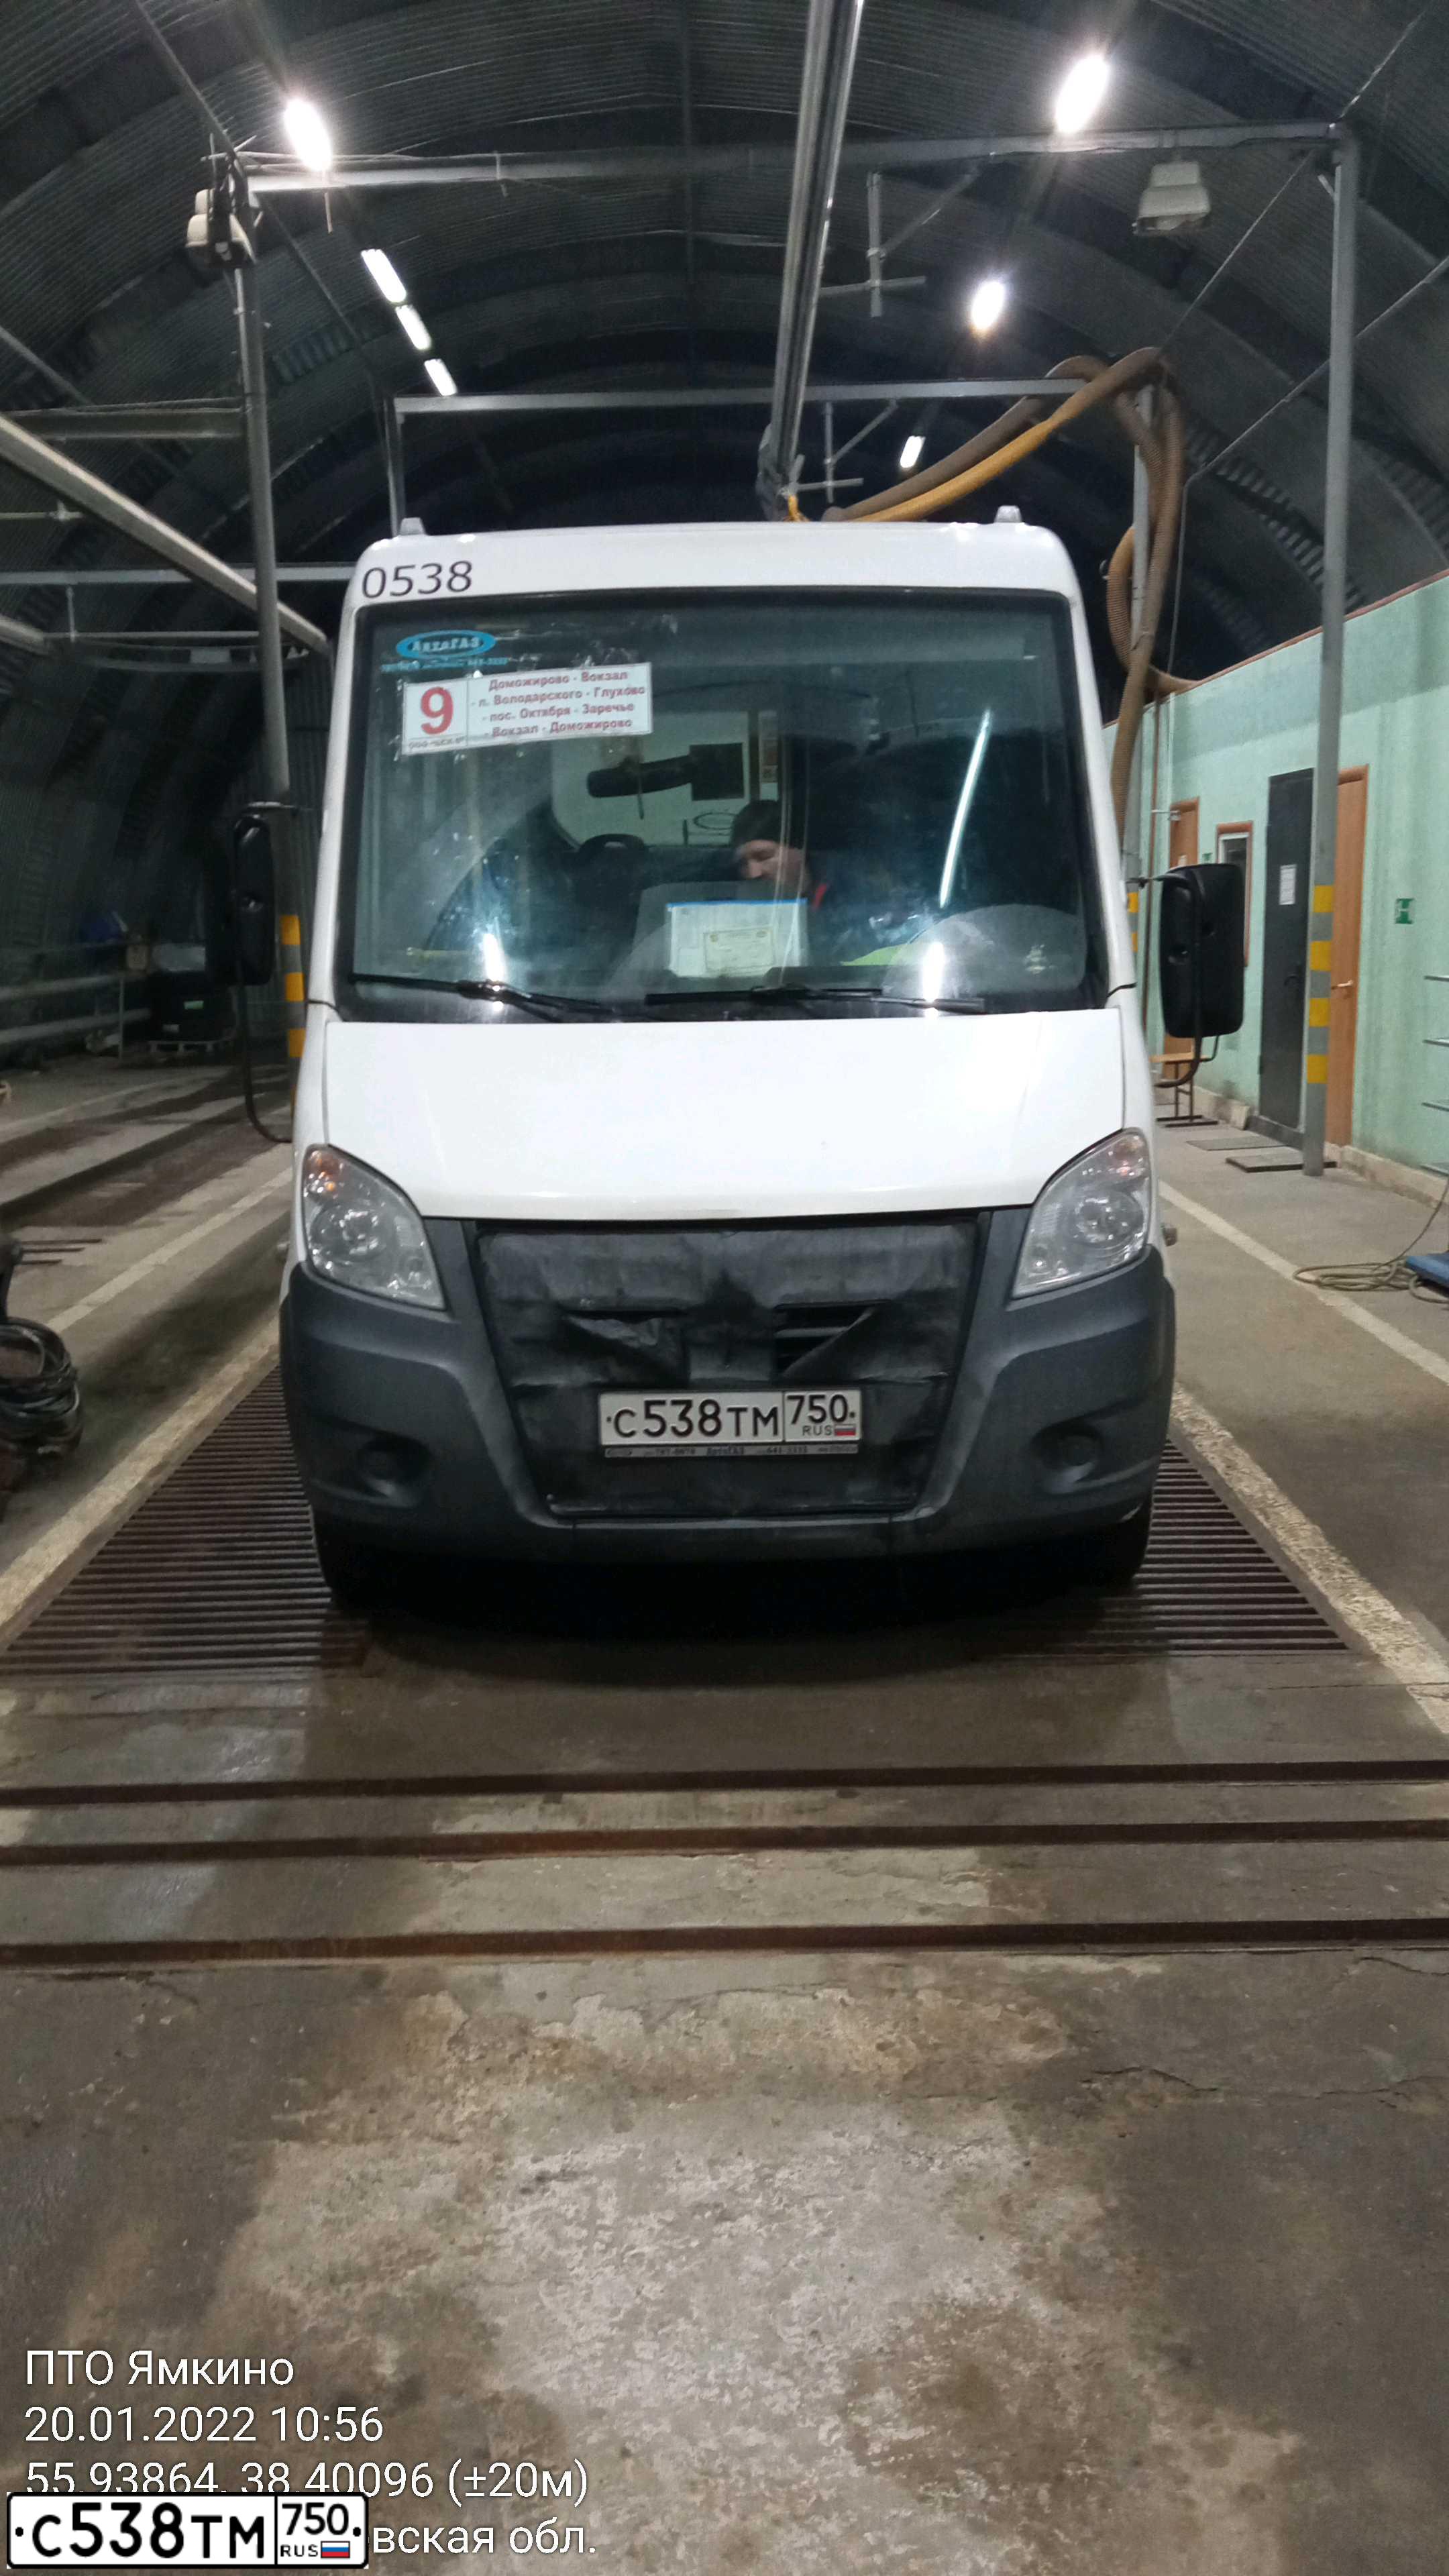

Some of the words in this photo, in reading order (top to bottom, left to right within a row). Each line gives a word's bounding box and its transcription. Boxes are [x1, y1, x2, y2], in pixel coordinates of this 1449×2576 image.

[362, 560, 473, 599] 0538
[489, 676, 569, 692] Доможирово
[581, 672, 628, 683] Вокзал
[494, 691, 582, 706] Володарского
[594, 686, 645, 699] Глухово
[420, 686, 454, 735] 9
[520, 705, 571, 718] Октября
[582, 703, 635, 714] Заречье
[492, 723, 539, 737] Вокзал
[550, 719, 633, 734] Доможирово
[787, 1393, 849, 1424] 750
[802, 1425, 833, 1436] RUS
